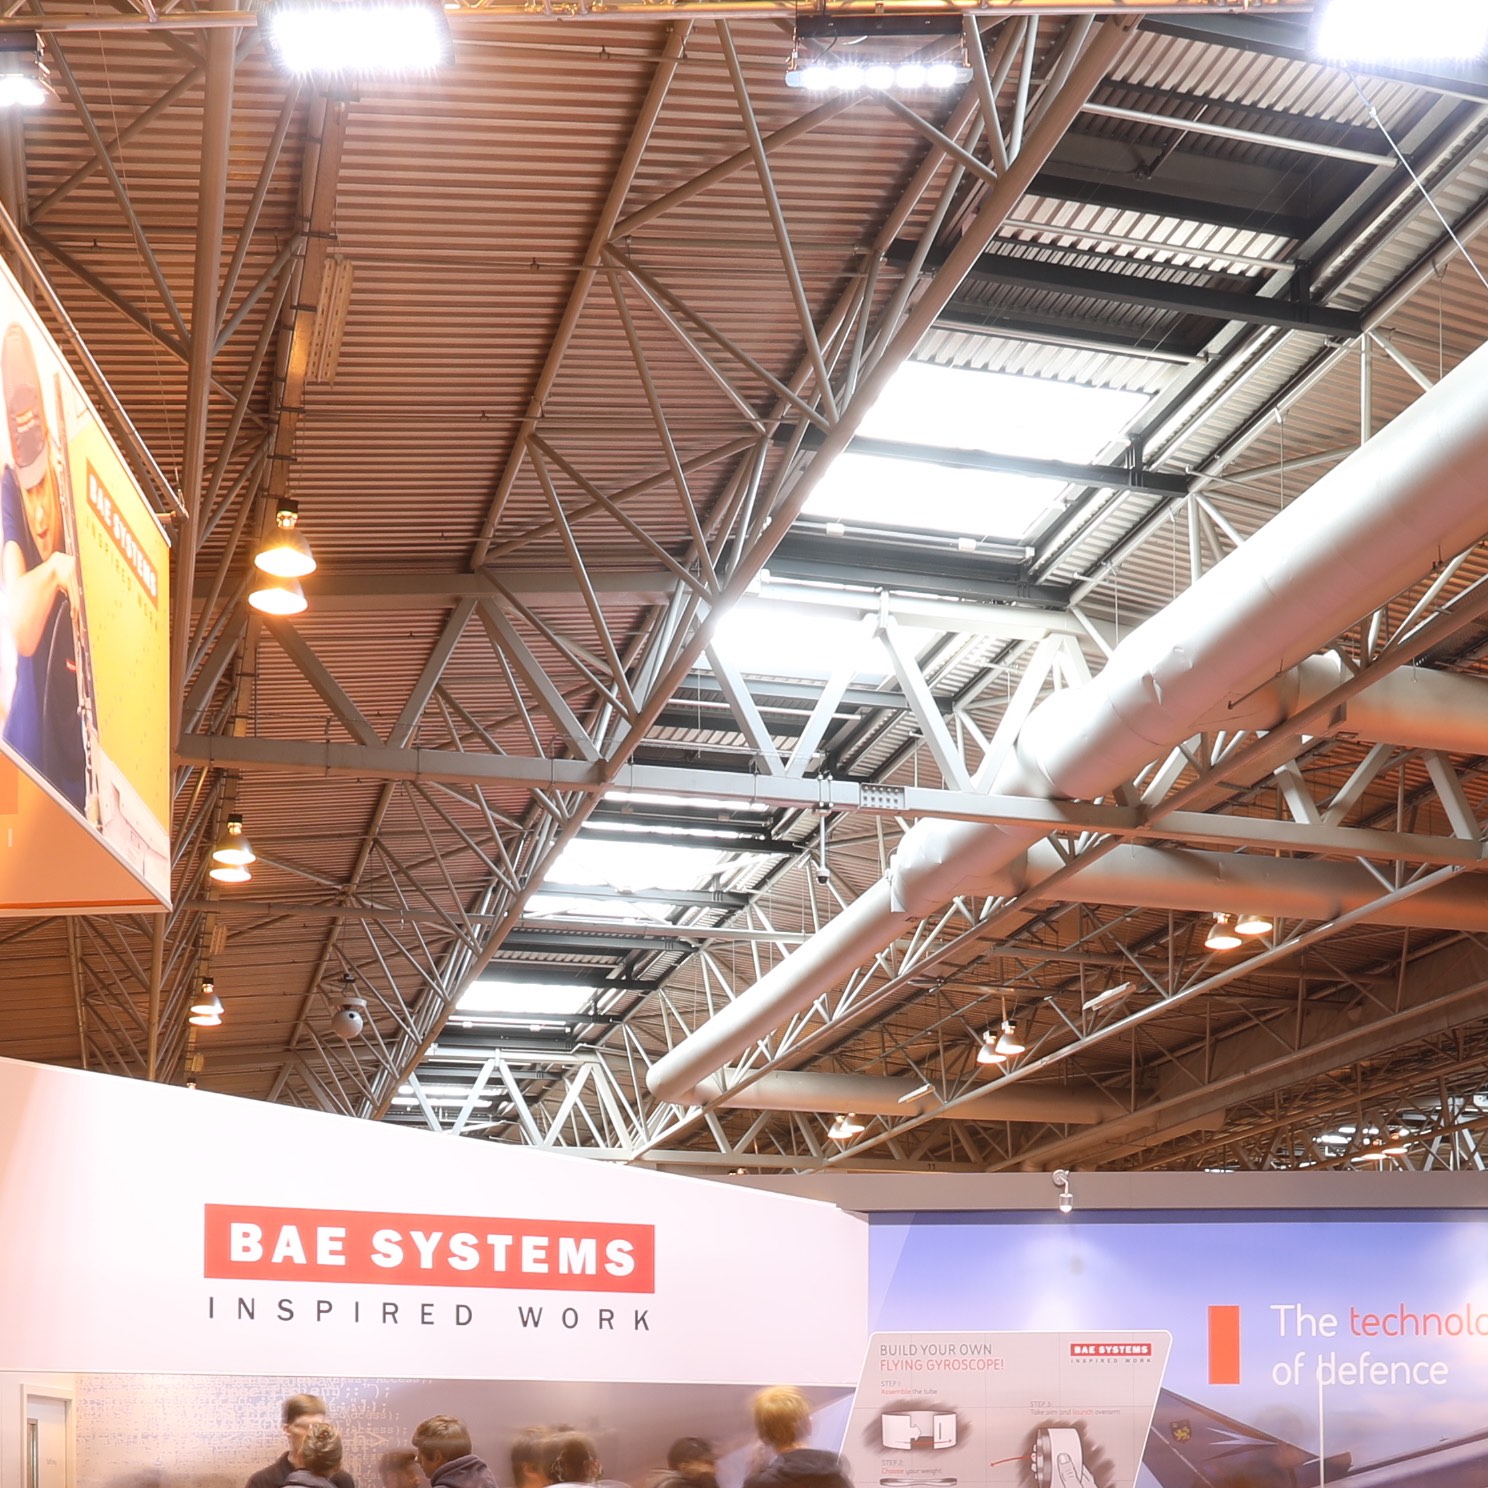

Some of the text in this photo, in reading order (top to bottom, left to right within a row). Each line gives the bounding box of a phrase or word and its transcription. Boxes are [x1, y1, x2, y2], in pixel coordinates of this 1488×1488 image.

[89, 473, 157, 597] BAE SYSTEMS
[230, 1222, 635, 1277] BAE SYSTEMS
[208, 1296, 650, 1331] INSPIRED WORK
[1270, 1303, 1338, 1337] The
[880, 1344, 992, 1356] BUILD YOUR OWN
[1074, 1345, 1148, 1354] BAE SYSTEMS
[880, 1359, 1004, 1371] FLYING GYROSCOPE!
[1272, 1351, 1449, 1386] of defence
[1059, 1408, 1071, 1416] and
[1072, 1408, 1093, 1416] launch
[921, 1468, 941, 1476] weight
